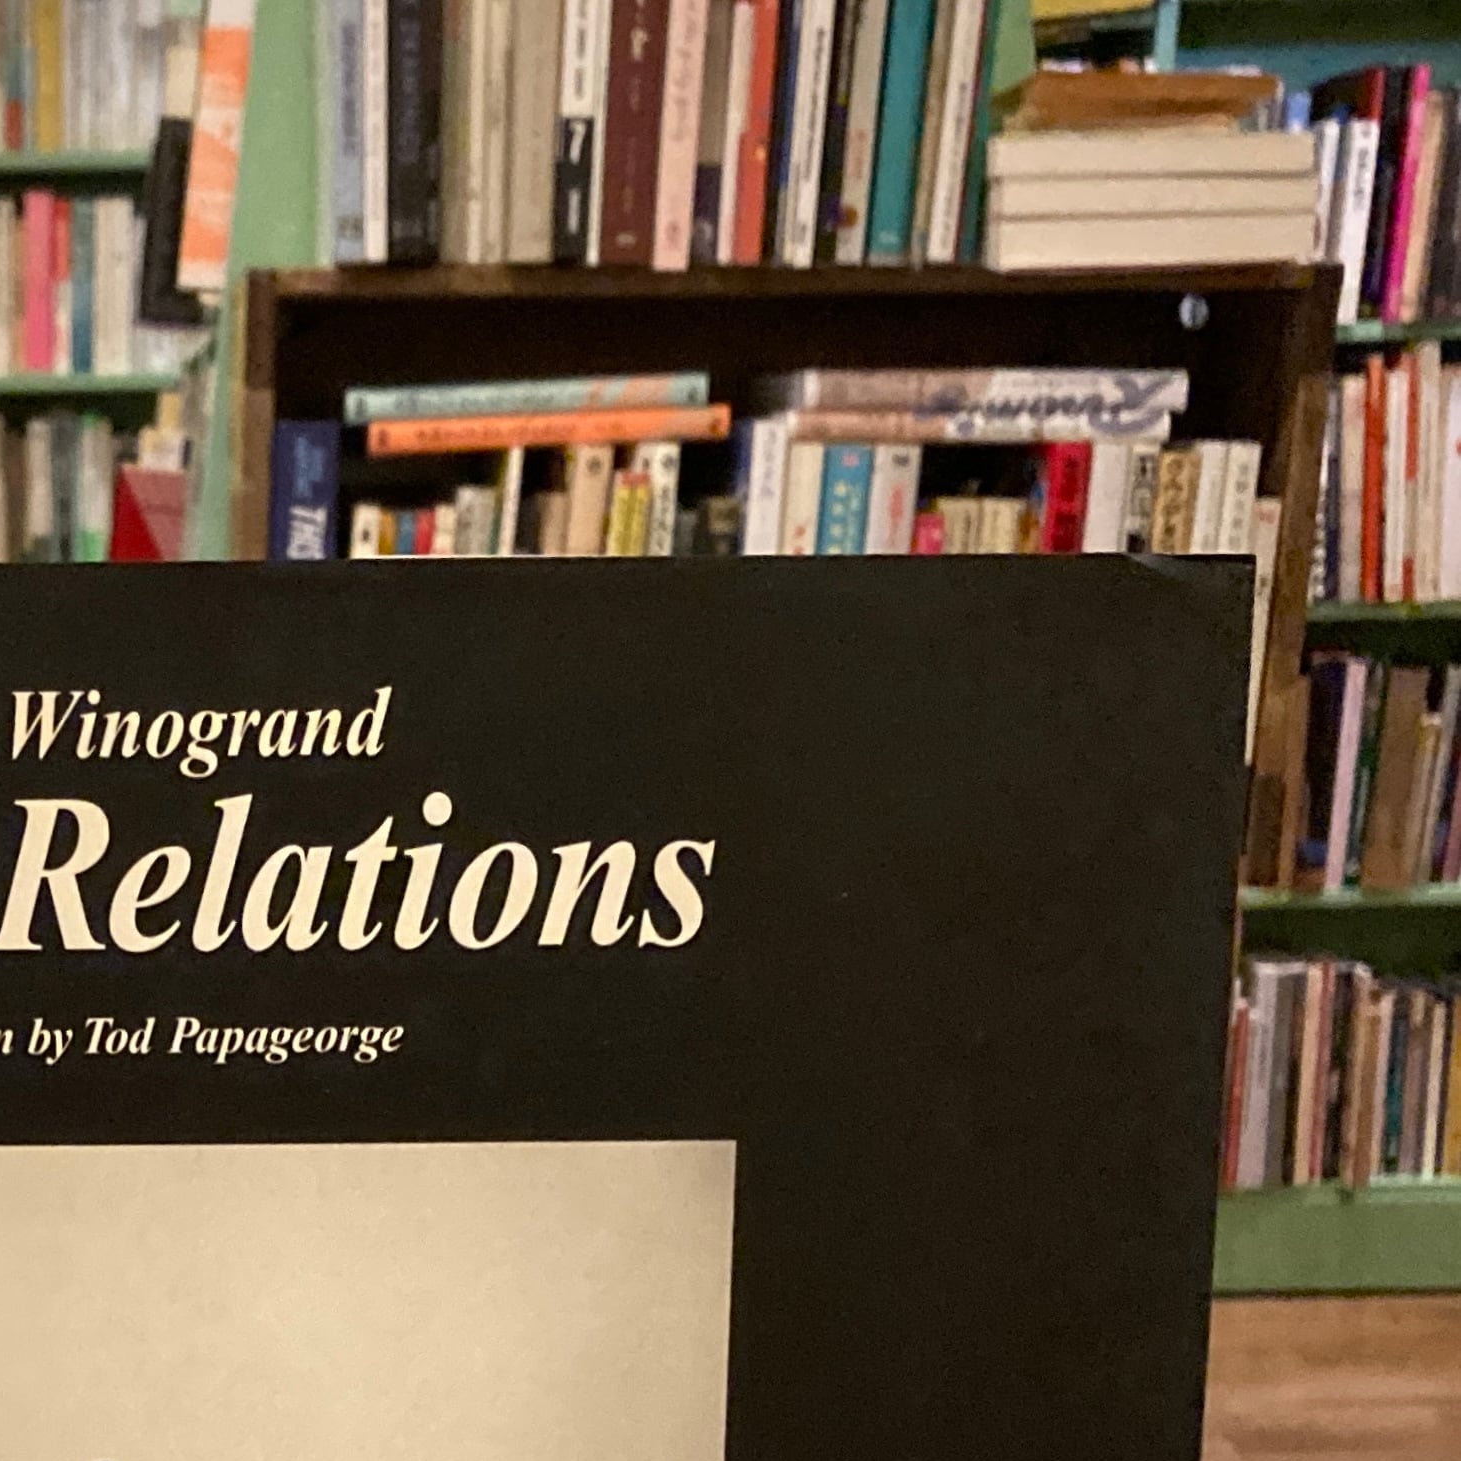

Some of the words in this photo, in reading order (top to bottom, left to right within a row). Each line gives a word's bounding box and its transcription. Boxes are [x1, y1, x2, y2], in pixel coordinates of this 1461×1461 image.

[12, 686, 393, 777] Winogrand
[27, 1017, 74, 1066] by
[85, 1017, 156, 1055] Tod
[168, 1017, 405, 1066] Papageorge
